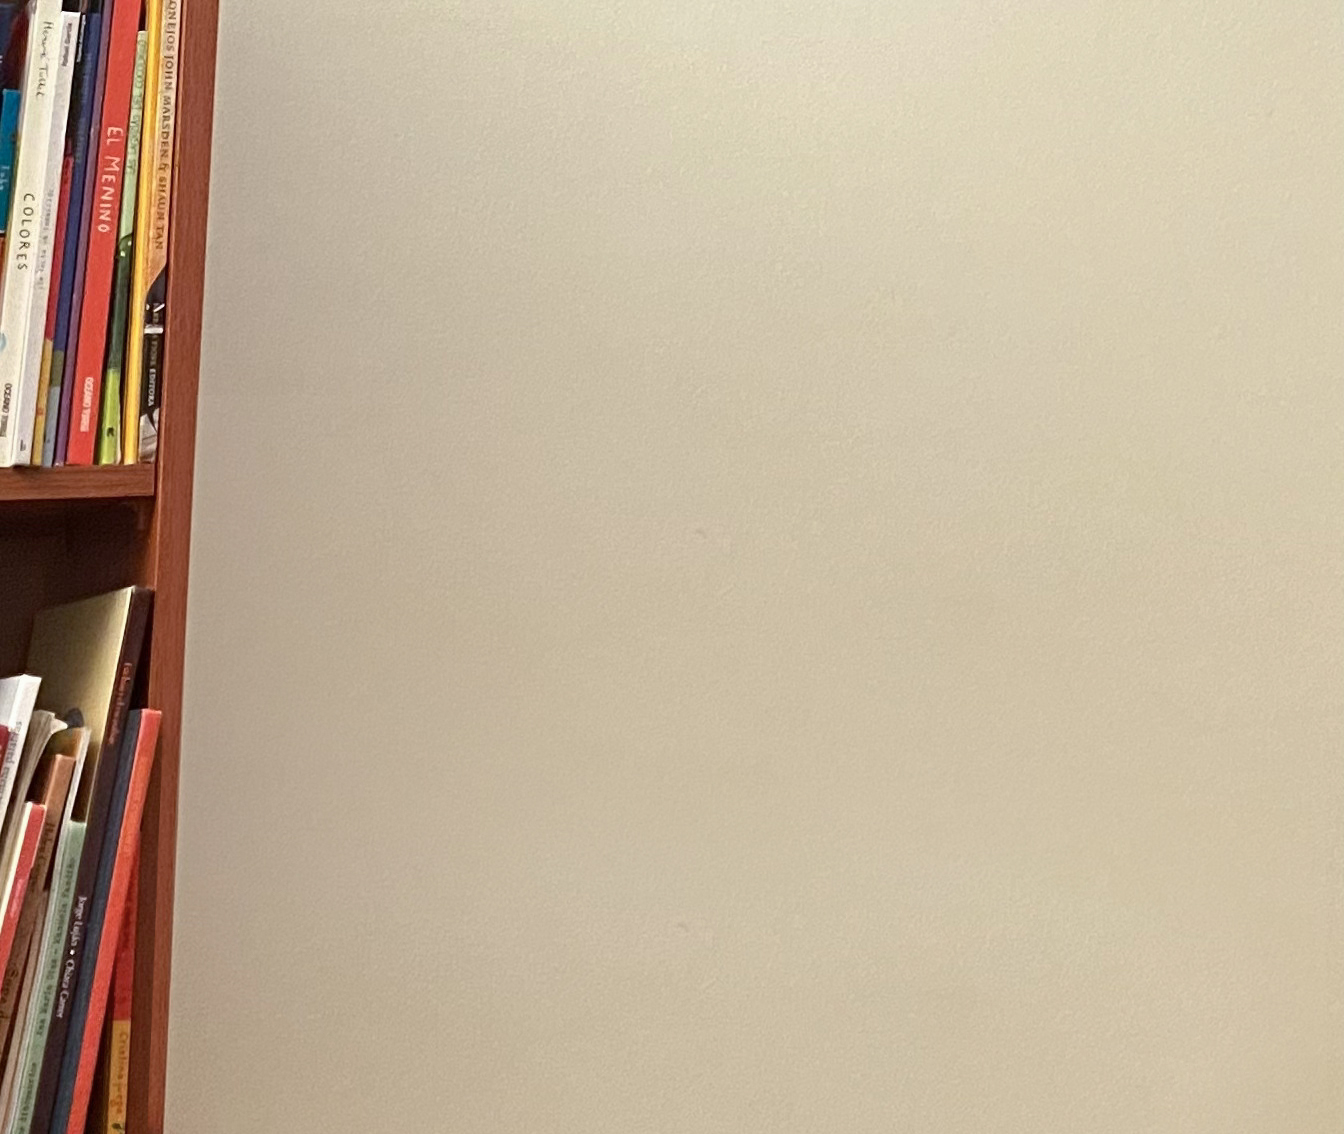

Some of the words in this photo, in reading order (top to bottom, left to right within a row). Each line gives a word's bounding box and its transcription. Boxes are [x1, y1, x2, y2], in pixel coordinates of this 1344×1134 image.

[161, 54, 176, 90] JOHN
[104, 126, 123, 146] EL
[158, 95, 173, 158] MARSDEN
[95, 155, 120, 233] MENINO
[154, 176, 167, 221] SHAUN
[15, 192, 35, 271] COLORES
[153, 224, 165, 250] TAN
